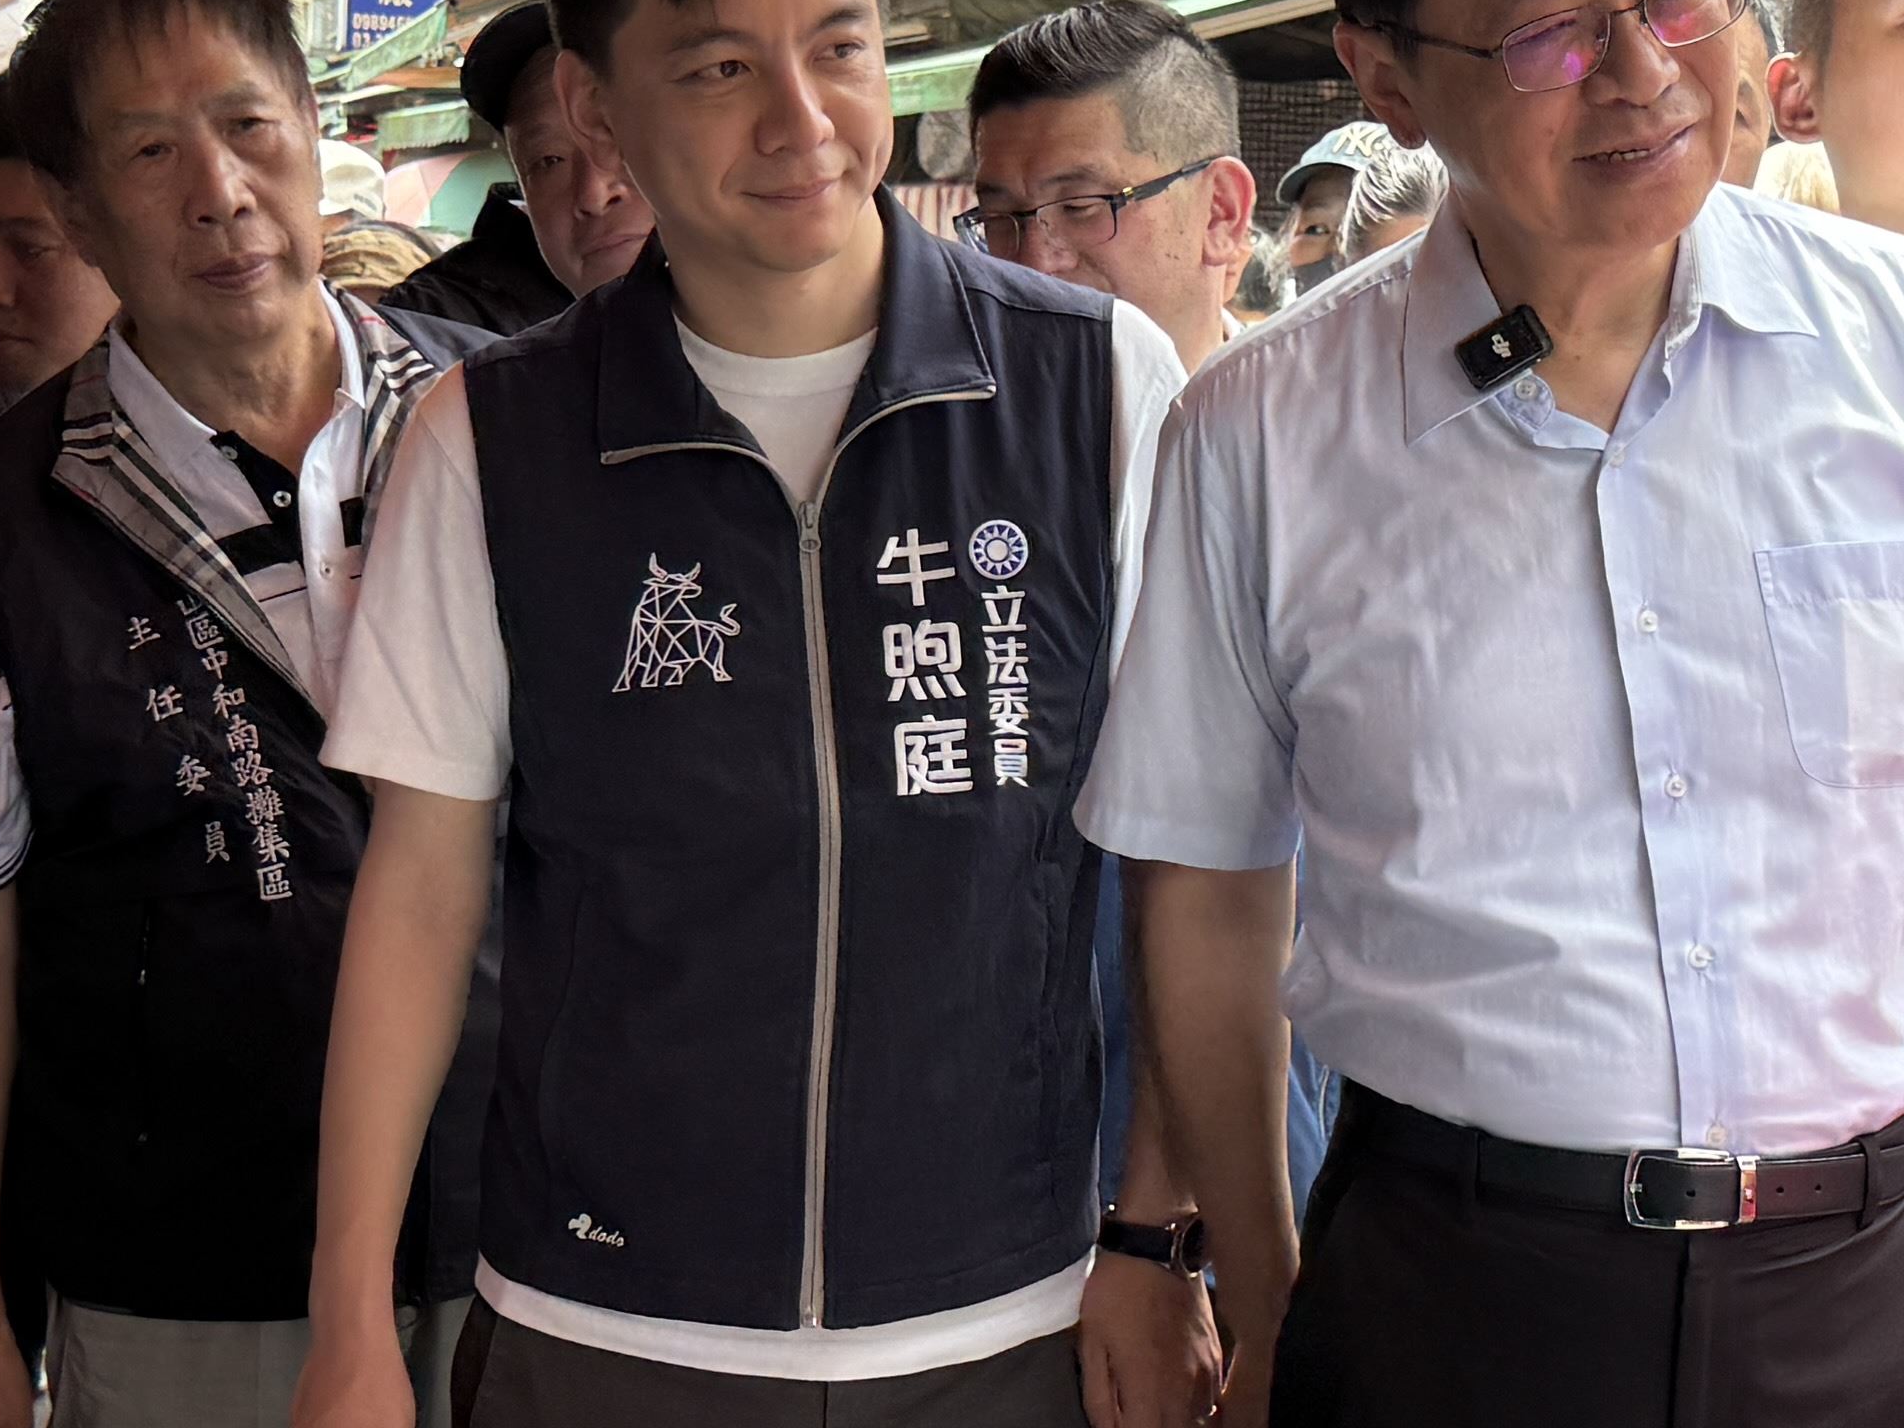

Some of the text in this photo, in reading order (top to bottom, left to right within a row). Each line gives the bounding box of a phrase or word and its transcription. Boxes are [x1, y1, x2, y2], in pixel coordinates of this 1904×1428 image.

[127, 616, 230, 864] 主任委員
[876, 527, 974, 797] 牛煦庭
[981, 585, 1029, 789] 立法委員
[588, 1225, 625, 1248] dodo
